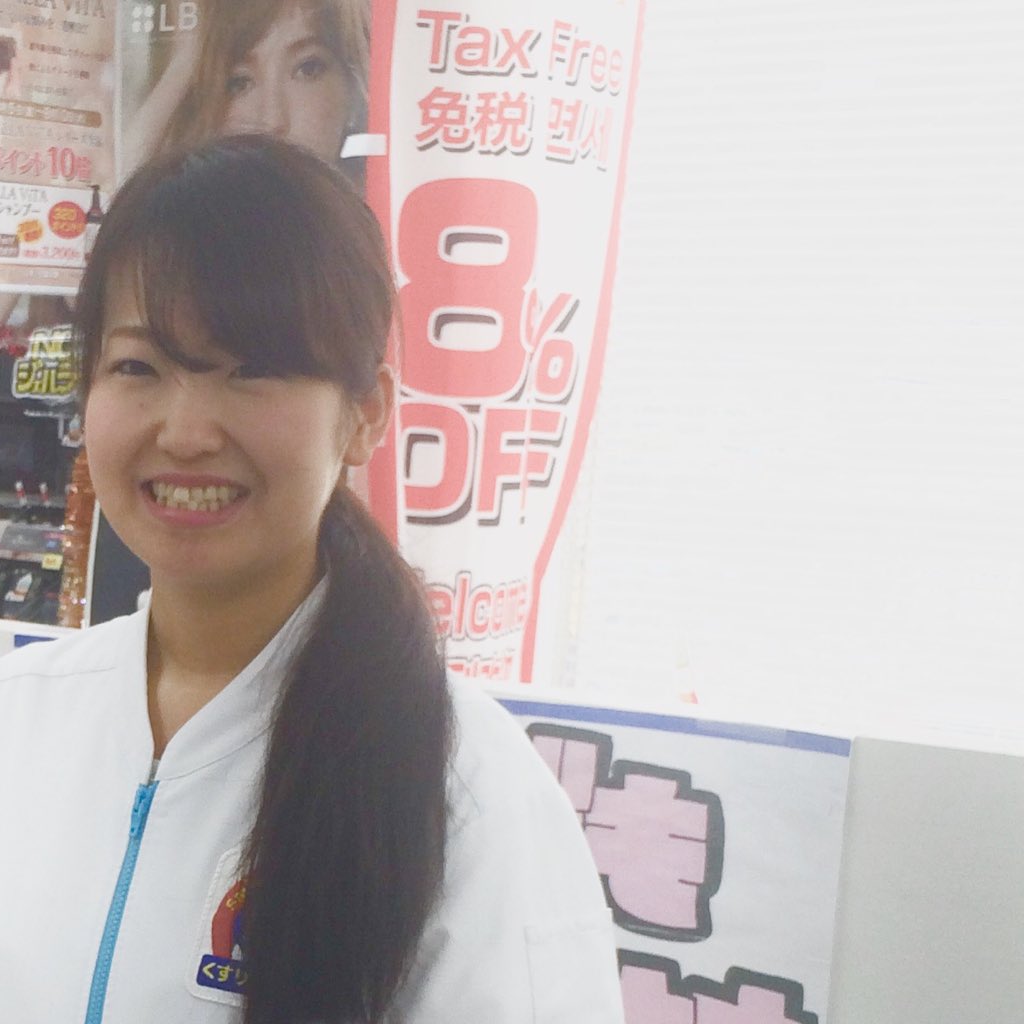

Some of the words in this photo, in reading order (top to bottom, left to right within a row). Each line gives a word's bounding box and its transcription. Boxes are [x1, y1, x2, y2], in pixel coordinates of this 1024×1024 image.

[416, 10, 534, 74] Tax
[551, 18, 624, 90] Free
[416, 86, 532, 152] 免税
